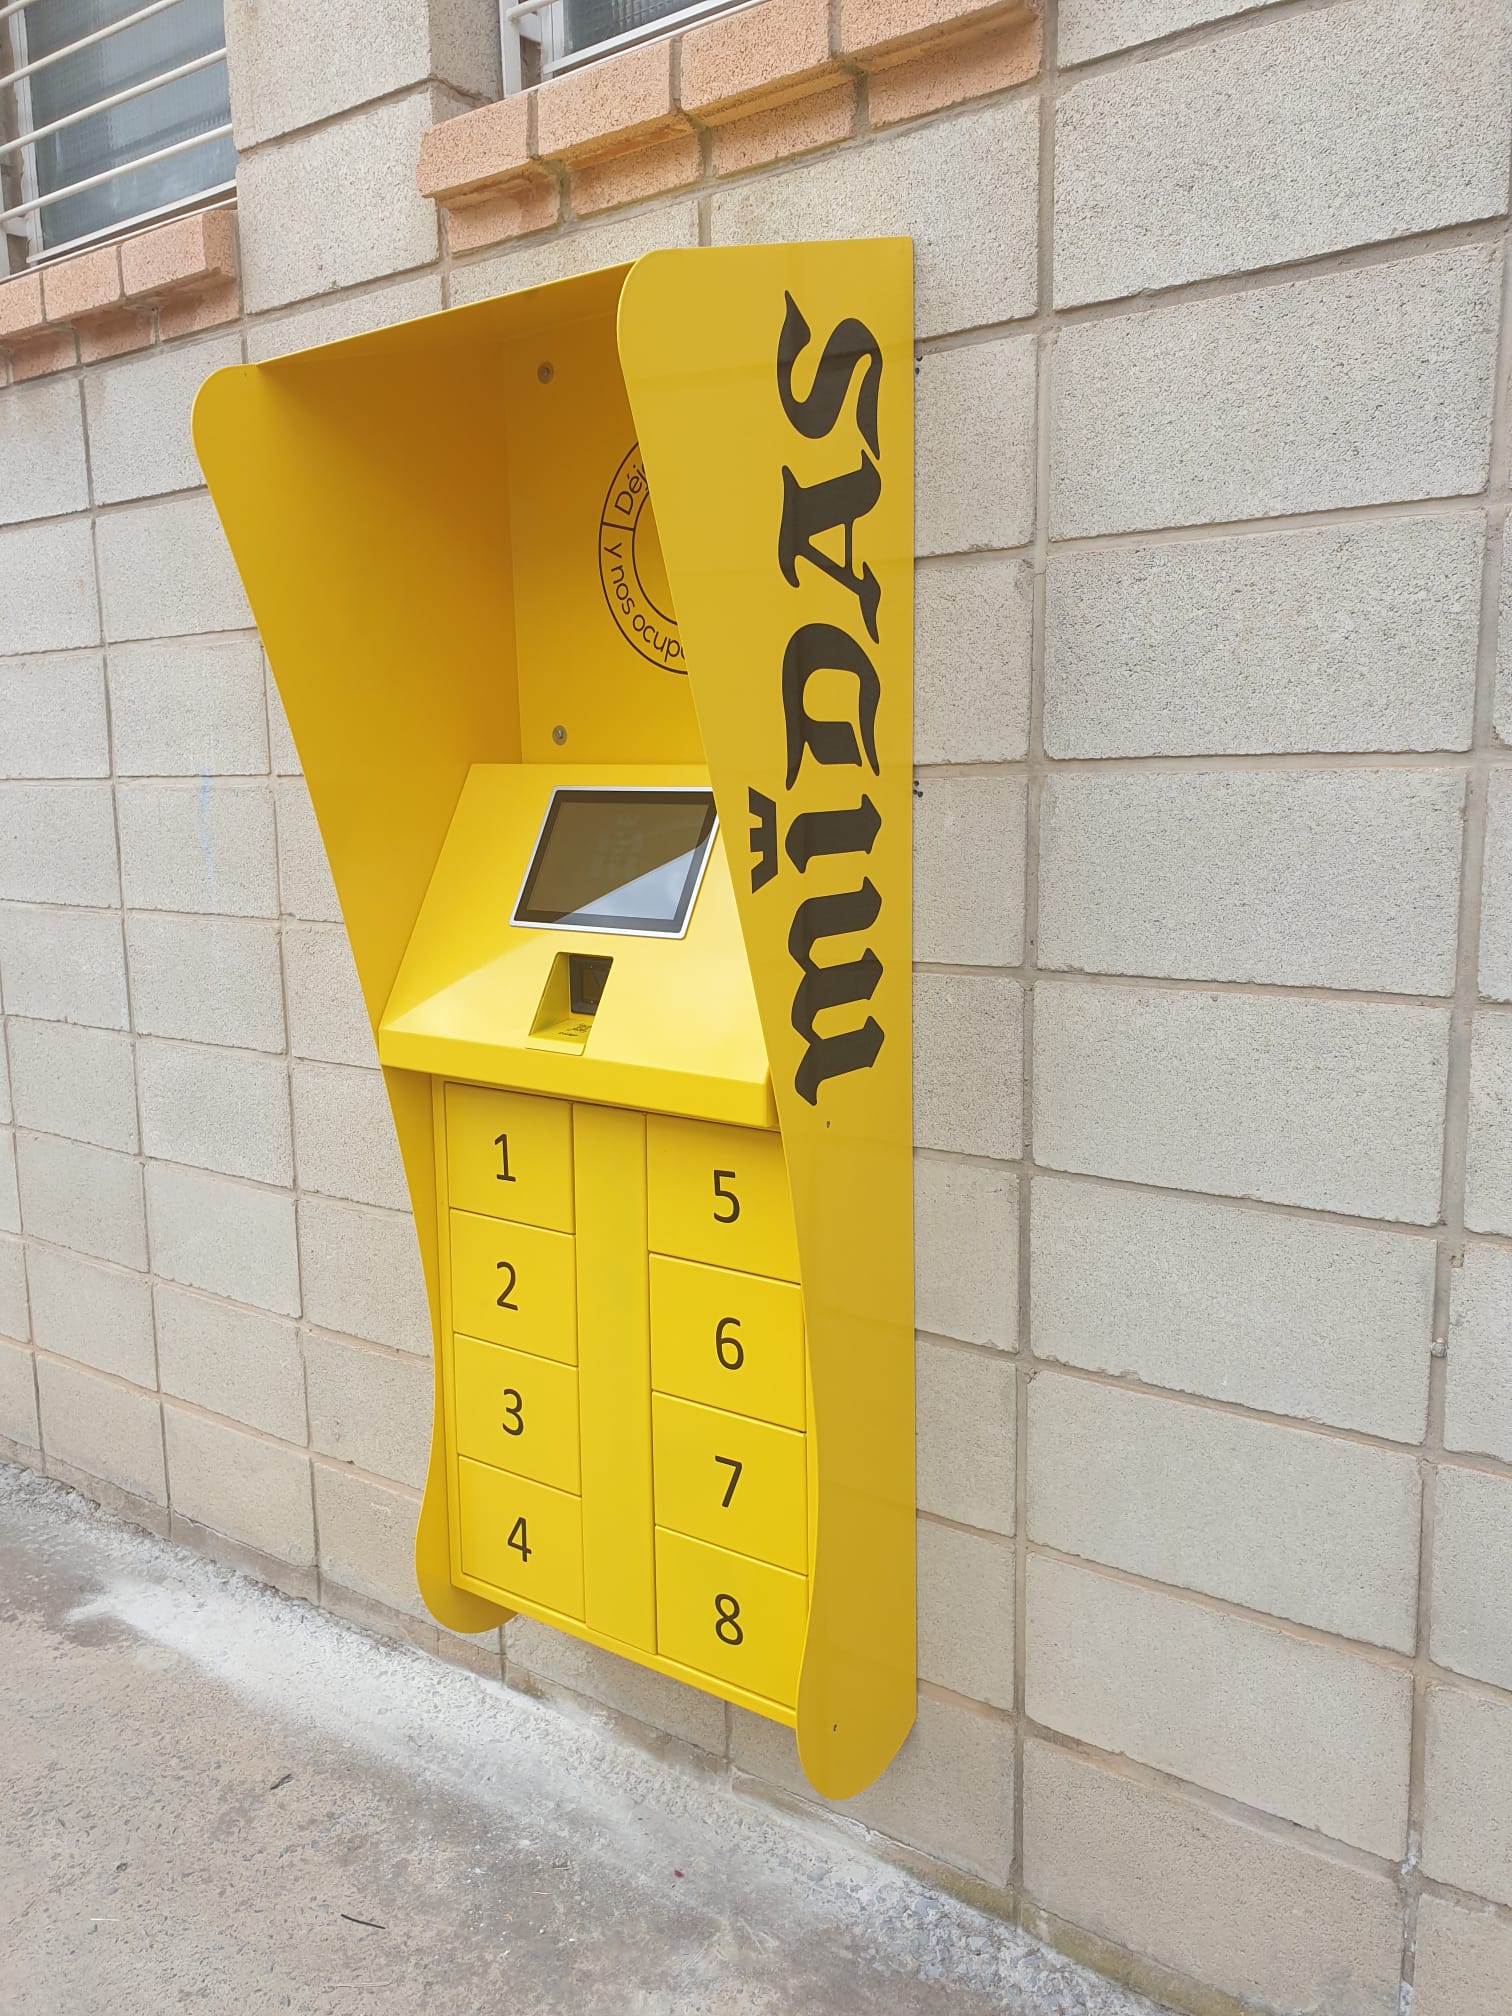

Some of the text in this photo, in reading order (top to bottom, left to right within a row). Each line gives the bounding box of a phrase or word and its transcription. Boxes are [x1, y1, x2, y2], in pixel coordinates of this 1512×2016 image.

[614, 462, 649, 516] Déj
[604, 541, 685, 663] Y nos ocup
[494, 1133, 517, 1183] 1
[712, 1169, 741, 1224] 5
[495, 1261, 519, 1311] 2
[715, 1317, 745, 1371] 6
[502, 1388, 525, 1436] 3
[714, 1455, 743, 1508] 7
[507, 1516, 532, 1563] 4
[714, 1593, 744, 1646] 8
